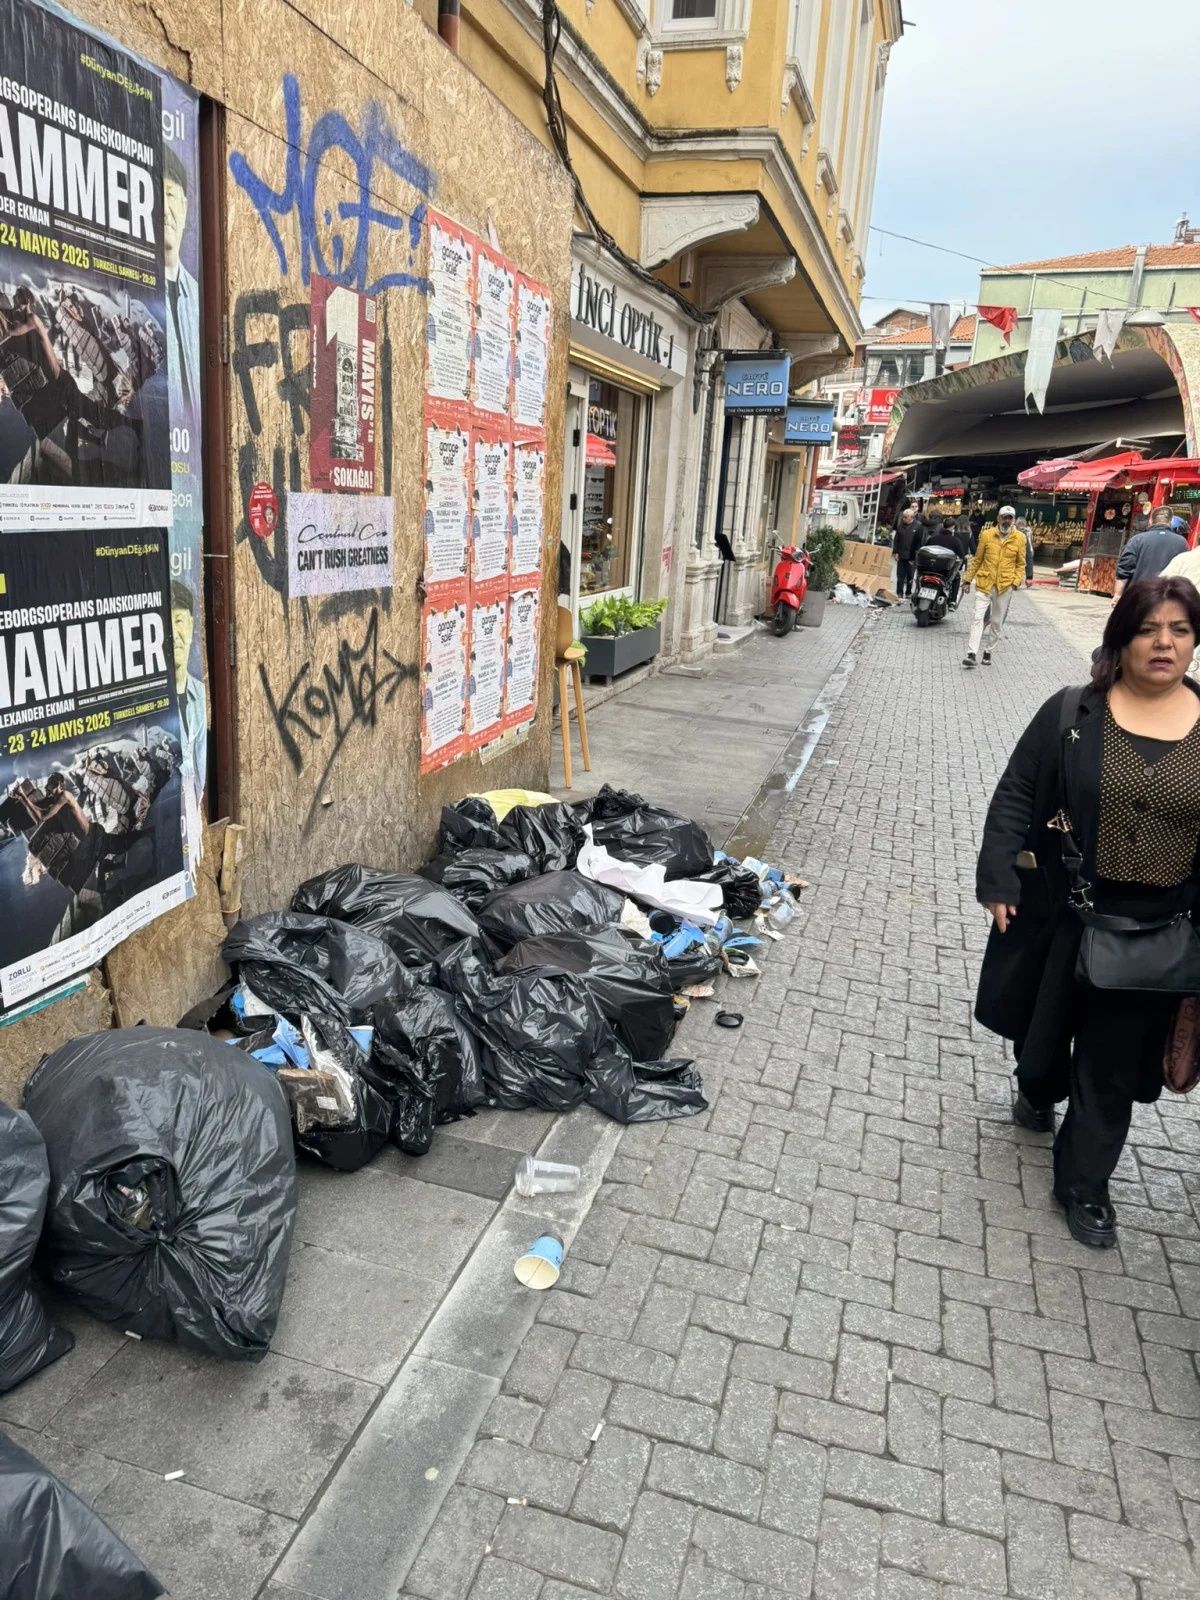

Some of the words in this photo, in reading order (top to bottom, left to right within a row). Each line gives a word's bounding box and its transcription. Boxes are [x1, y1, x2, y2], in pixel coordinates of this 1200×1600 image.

[0, 76, 77, 131] GSOPERANS
[79, 113, 154, 167] DANSKOMPANI
[18, 201, 50, 228] EKMAN
[0, 223, 17, 247] 24
[20, 228, 60, 261] MAYIS
[62, 242, 90, 270] 2025
[727, 382, 783, 396] NERO
[788, 422, 830, 432] NERO
[439, 442, 459, 457] garage
[443, 454, 454, 466] sale
[485, 454, 500, 467] garage
[333, 466, 373, 489] SOKAĞA!
[170, 547, 191, 576] gil
[298, 550, 323, 571] CAN'T
[325, 548, 347, 569] RUSH
[348, 546, 389, 567] GREATNESS
[96, 591, 161, 616] DANSKOMPANI
[438, 619, 456, 636] garage
[481, 614, 497, 629] garage
[441, 633, 451, 643] sale
[46, 698, 75, 717] EKMAN
[8, 733, 25, 754] 23
[31, 728, 47, 748] 24
[48, 718, 84, 743] MAYIS
[85, 711, 111, 732] 2025
[8, 964, 32, 981] ZORLU
